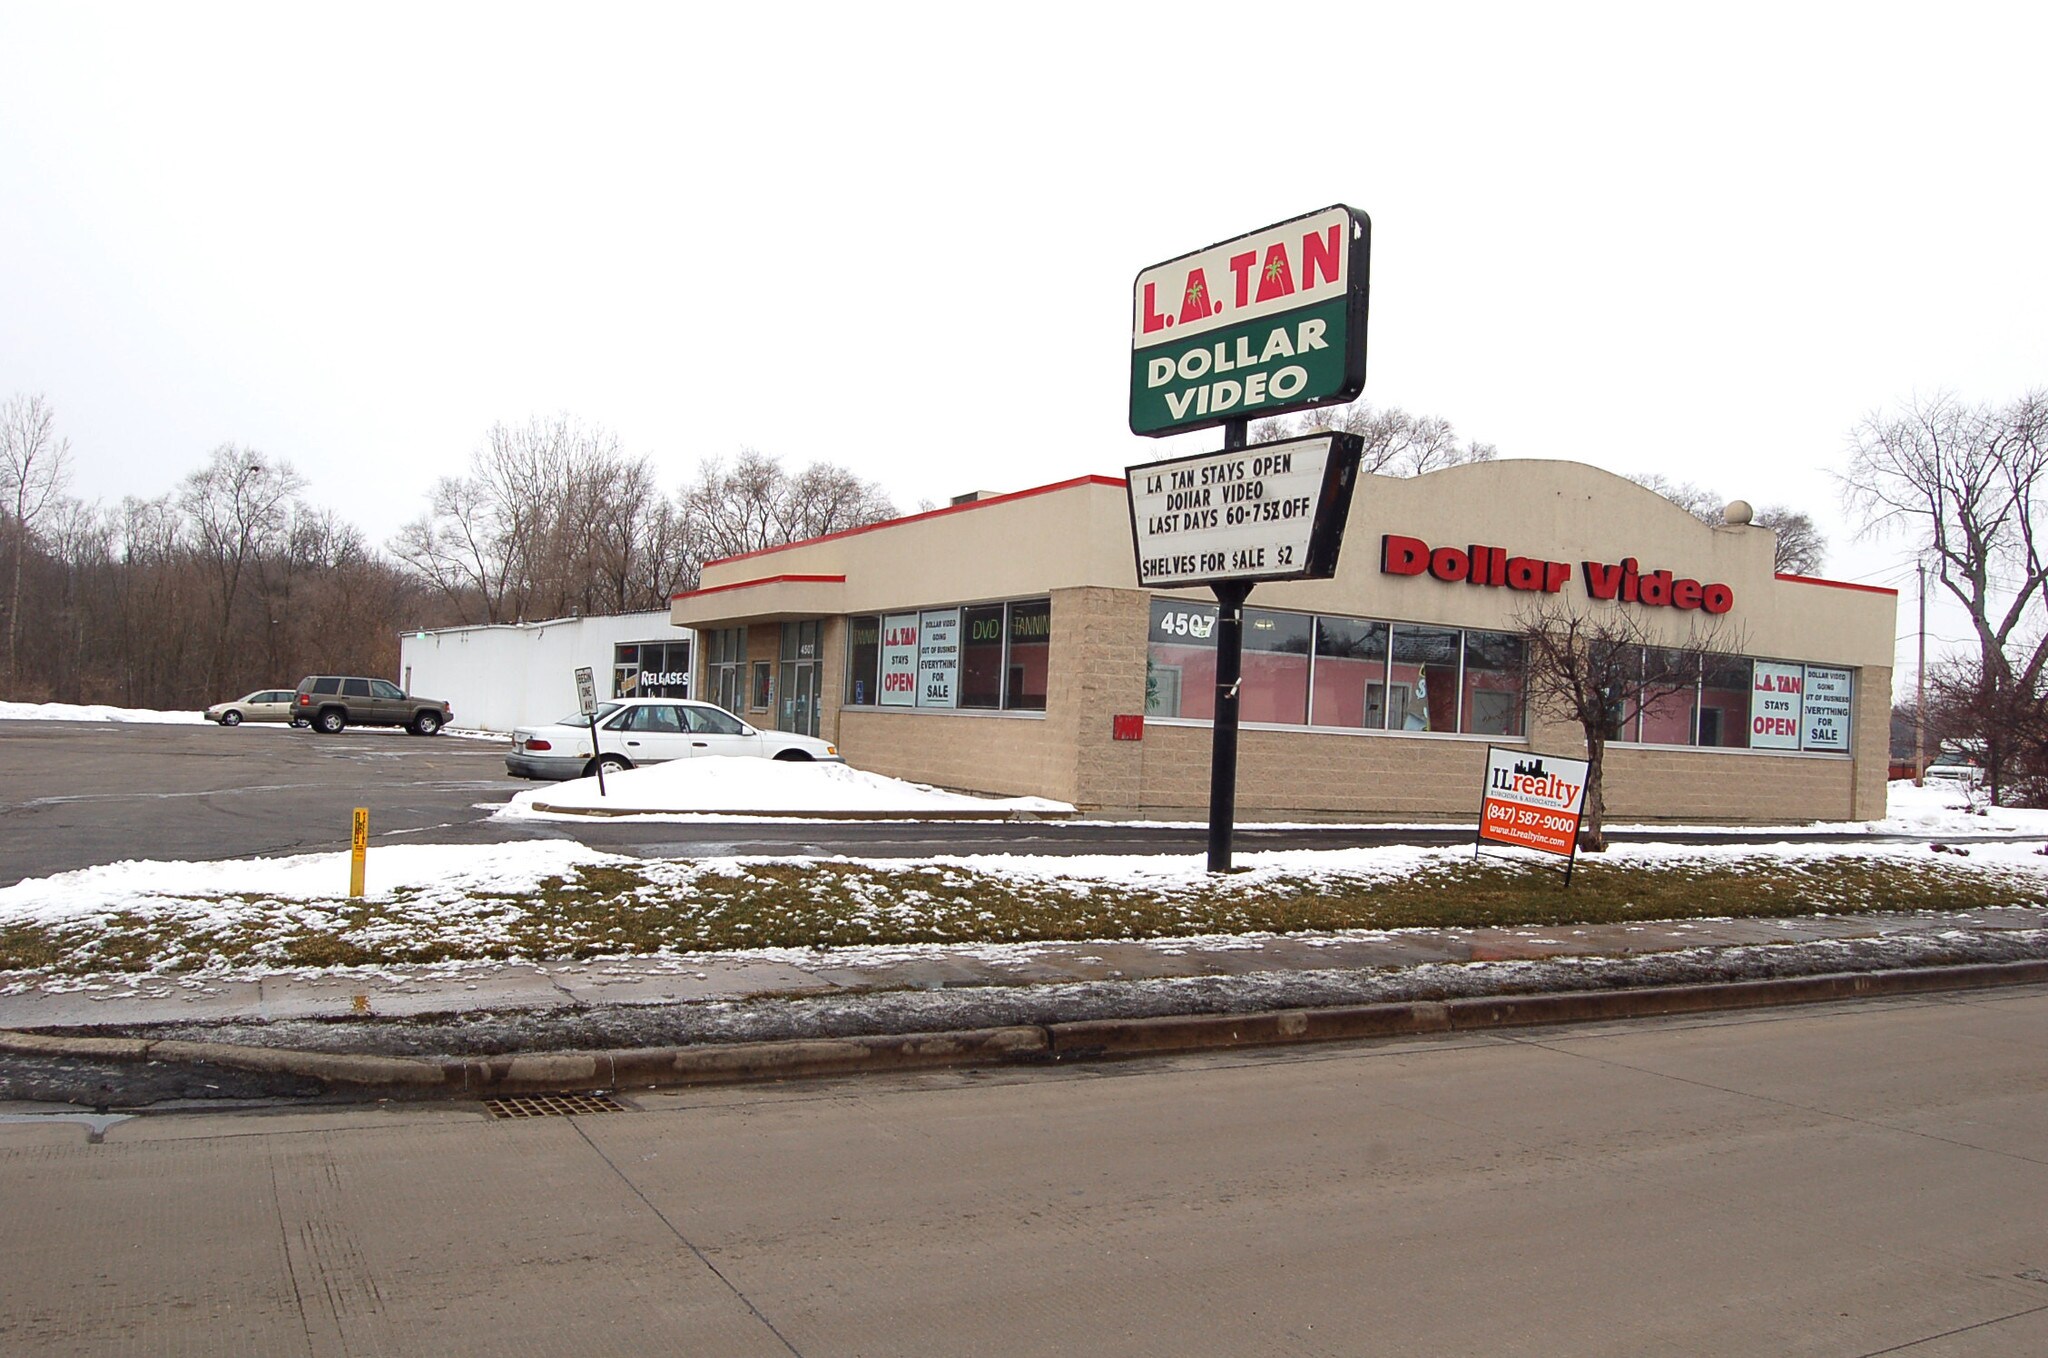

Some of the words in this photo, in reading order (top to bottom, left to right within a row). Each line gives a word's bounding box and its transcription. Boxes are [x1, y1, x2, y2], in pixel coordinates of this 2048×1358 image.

[1143, 267, 1223, 334] L.A.
[1229, 224, 1341, 309] TAN
[1148, 318, 1329, 388] DOLLAR
[1164, 365, 1308, 420] VIDEO
[1147, 475, 1162, 494] LA
[1171, 470, 1195, 490] TAN
[1201, 461, 1244, 485] STAYS
[1253, 453, 1292, 477] OPEN
[1222, 481, 1263, 503] VIDEO
[1149, 514, 1179, 535] LAST
[1184, 509, 1218, 531] DAYS
[1282, 497, 1310, 519] OFF
[1143, 555, 1196, 576] SHELVES
[1201, 552, 1226, 572] FOR
[1277, 545, 1292, 565] $2
[1380, 534, 1571, 593] Dollar
[1581, 557, 1734, 614] Video
[972, 619, 999, 640] DVD
[1161, 612, 1216, 638] 4507
[900, 627, 917, 645] TAN
[891, 655, 908, 665] STAYS
[920, 659, 957, 670] EVERYTHING
[885, 673, 914, 691] OPEN
[932, 672, 944, 682] FOR
[1777, 675, 1801, 694] TAN
[1808, 671, 1828, 679] DOLLAR
[1830, 673, 1846, 681] VIDEO
[927, 685, 949, 698] SALE
[1817, 683, 1834, 691] GOING
[1764, 700, 1789, 711] STAYS
[1753, 716, 1796, 736] OPEN
[1818, 718, 1832, 726] FOR
[1811, 728, 1837, 740] SALE
[1487, 802, 1516, 824] (847)
[1517, 811, 1574, 833] 587-9000
